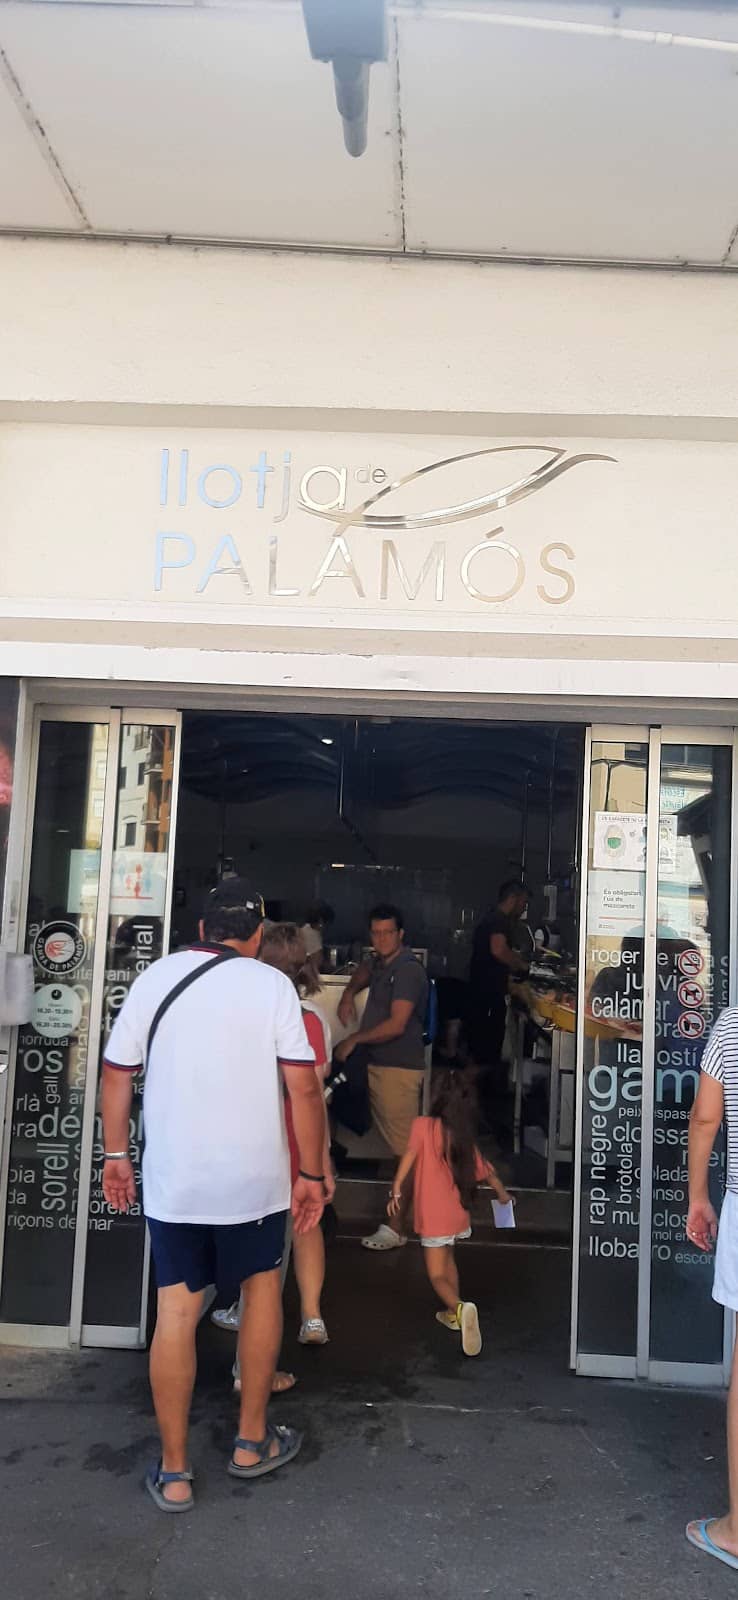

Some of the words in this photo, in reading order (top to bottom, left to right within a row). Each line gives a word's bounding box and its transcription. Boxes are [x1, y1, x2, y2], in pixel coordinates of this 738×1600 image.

[159, 448, 347, 521] llotja
[354, 464, 388, 484] de
[153, 527, 576, 604] PALAMÓS
[592, 950, 640, 967] roger
[43, 1075, 61, 1104] gall
[37, 1142, 69, 1211] sorell
[591, 1114, 611, 1180] negre
[616, 1143, 633, 1204] bròtola
[59, 1213, 76, 1228] de
[589, 1188, 610, 1225] rap
